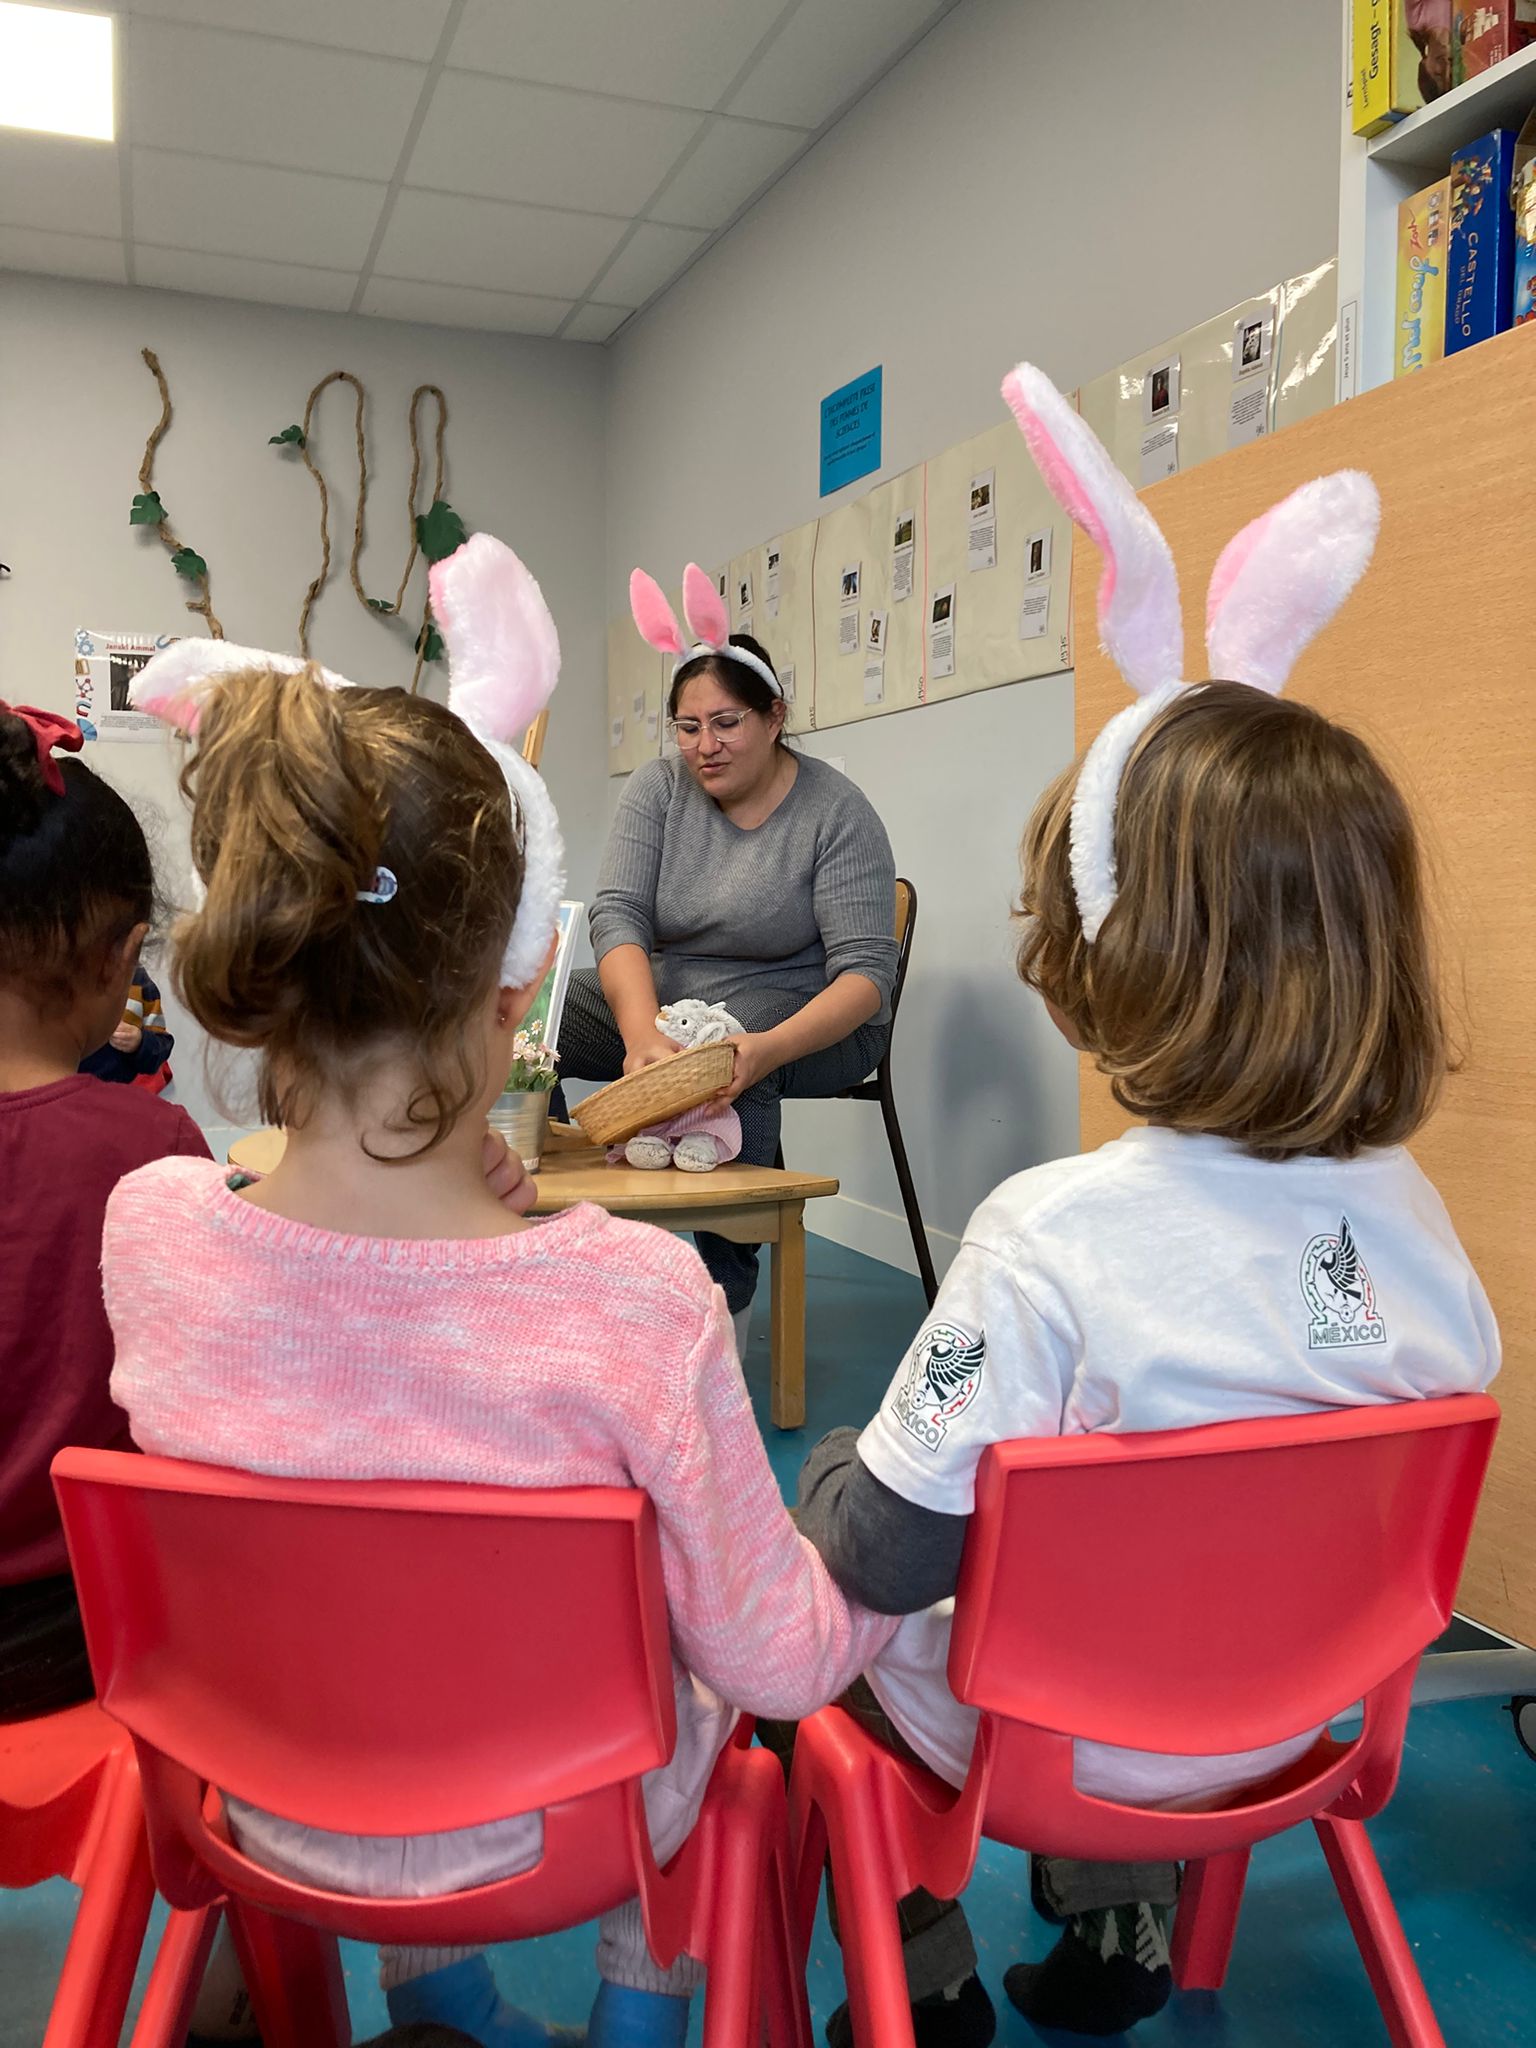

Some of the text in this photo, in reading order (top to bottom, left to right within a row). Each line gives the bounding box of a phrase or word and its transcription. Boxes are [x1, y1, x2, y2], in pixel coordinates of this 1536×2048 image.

[1369, 21, 1381, 79] Gesagt
[1462, 232, 1479, 337] CASTELLO
[1312, 1323, 1382, 1345] MÉXICO
